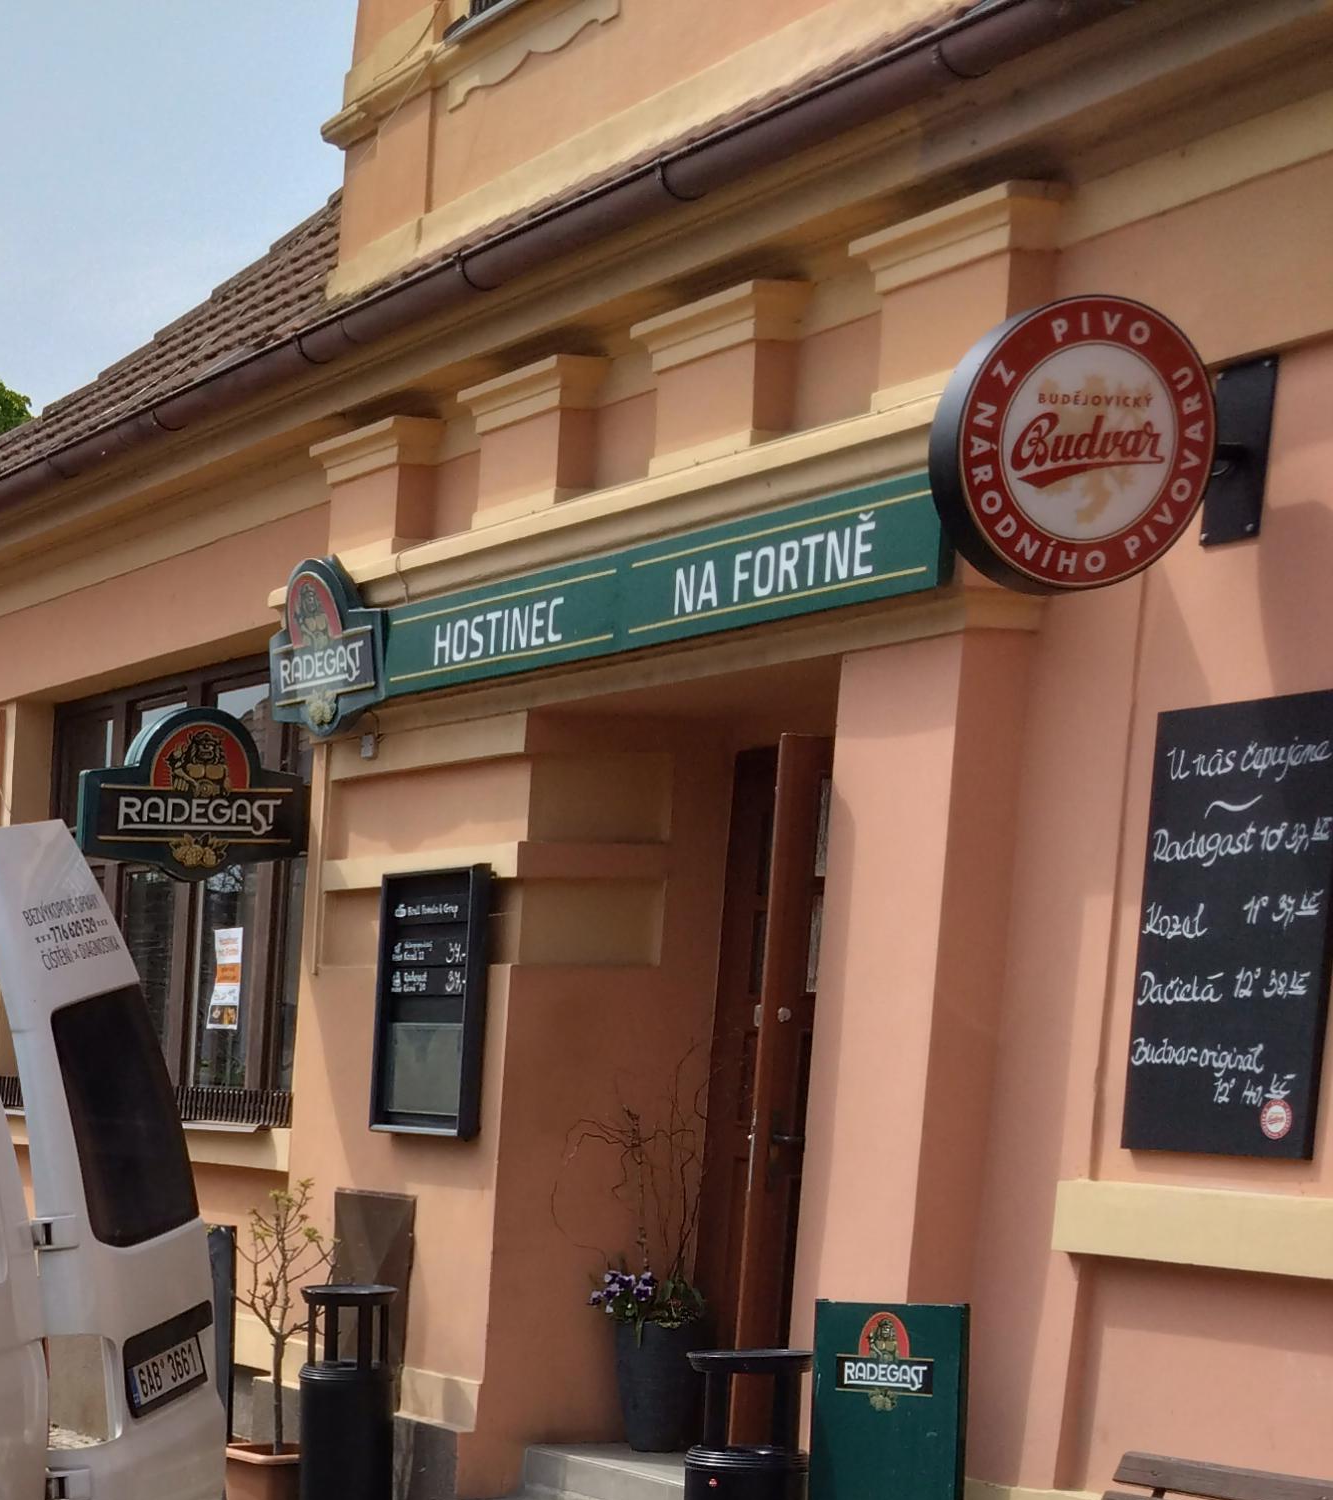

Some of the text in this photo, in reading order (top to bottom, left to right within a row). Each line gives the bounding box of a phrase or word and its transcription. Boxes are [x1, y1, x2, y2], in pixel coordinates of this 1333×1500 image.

[1037, 390, 1154, 409] BUDĚJOVICKÝ
[970, 312, 1205, 574] PIVO Z NÁRODNÍHO PIVOVARU
[1010, 411, 1165, 473] Budvar
[674, 511, 876, 616] NA FORTNĚ
[433, 596, 564, 666] HOSTINEC
[279, 639, 364, 691] RADEGAST
[1166, 746, 1190, 781] U
[1191, 748, 1237, 778] nás
[117, 796, 282, 837] RADEGAST
[1153, 821, 1257, 868] Radegast
[1142, 901, 1209, 940] Kozel
[844, 1361, 928, 1391] RADEGAST
